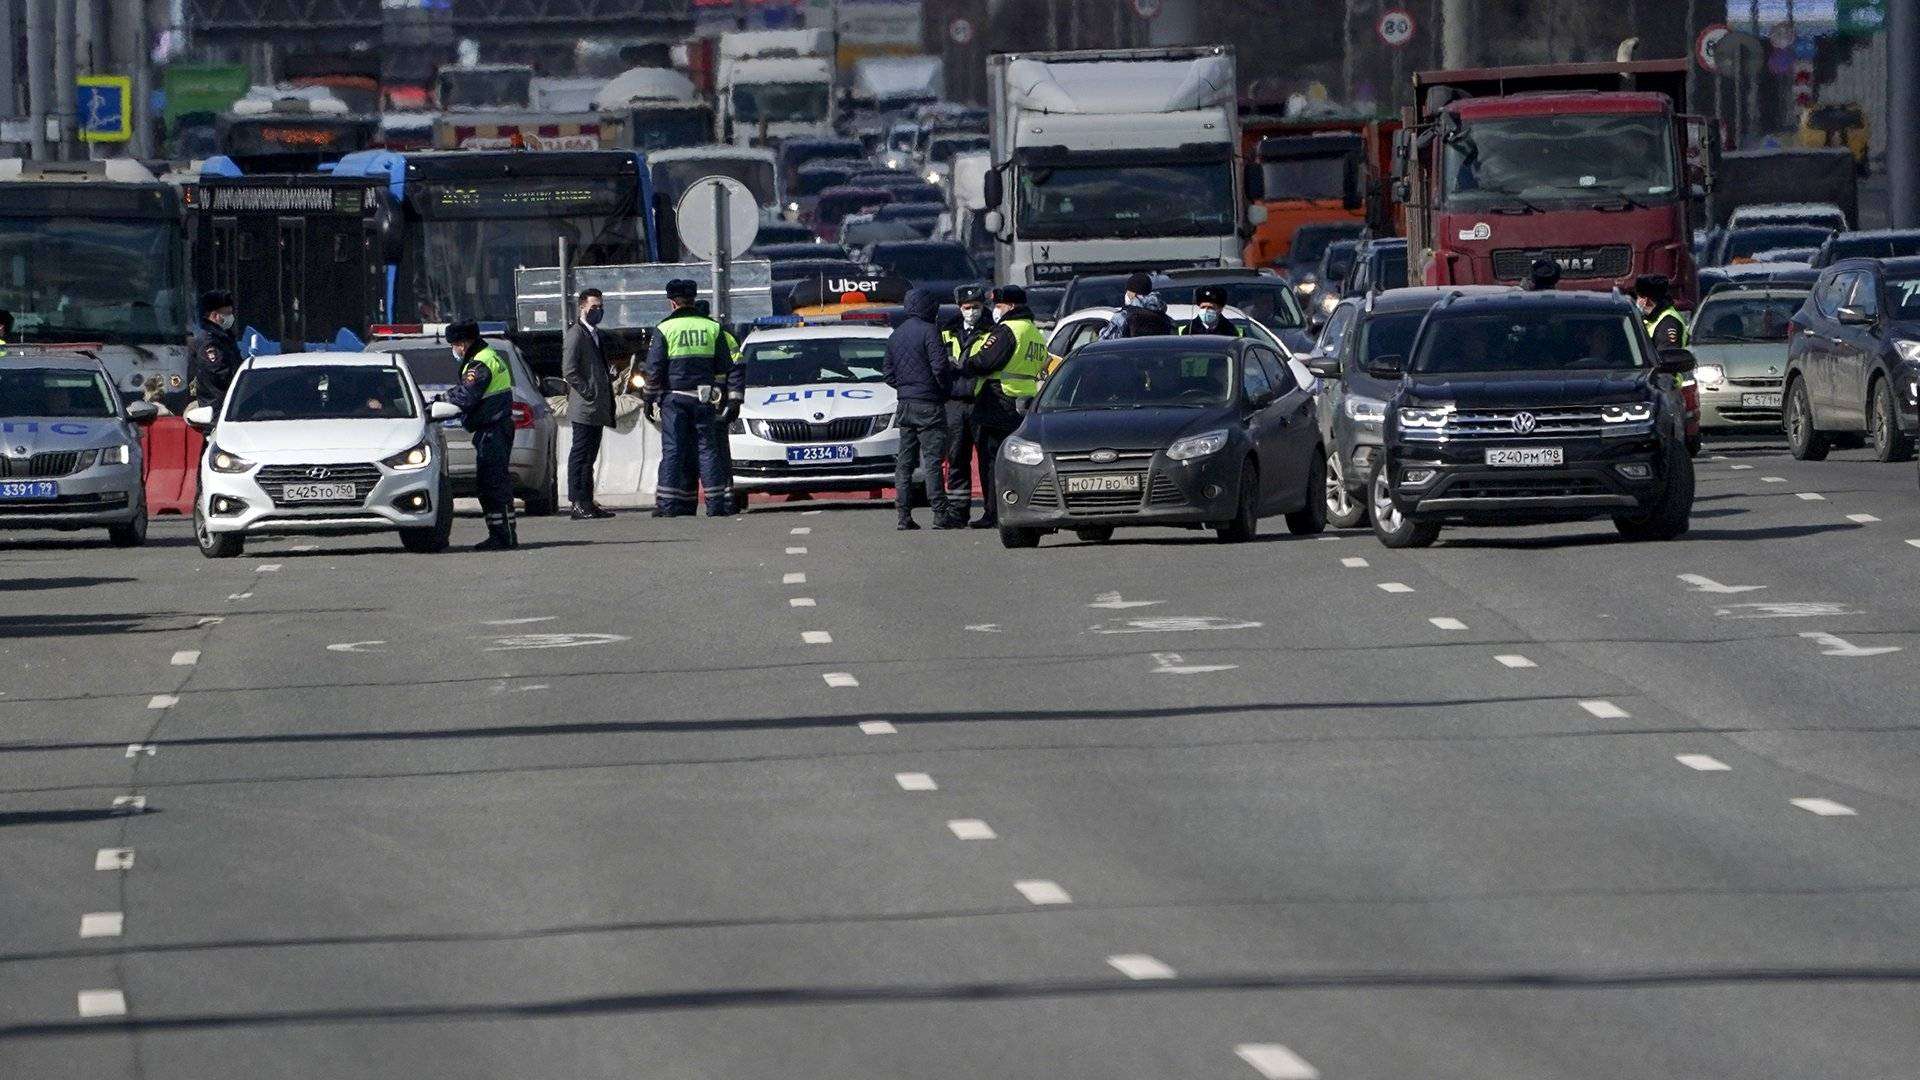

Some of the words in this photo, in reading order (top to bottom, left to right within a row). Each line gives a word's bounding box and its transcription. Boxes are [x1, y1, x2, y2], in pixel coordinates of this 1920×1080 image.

[1384, 20, 1408, 35] 80
[1036, 266, 1072, 275] DAF
[828, 279, 879, 293] Uber
[679, 329, 708, 347] ДПС
[762, 388, 876, 405] ДПС
[803, 448, 832, 459] 2334
[838, 446, 849, 455] 99
[1541, 450, 1560, 459] 198
[1124, 476, 1135, 486] 18
[3, 483, 33, 496] 3391
[39, 482, 53, 491] 99
[335, 485, 352, 494] 750
